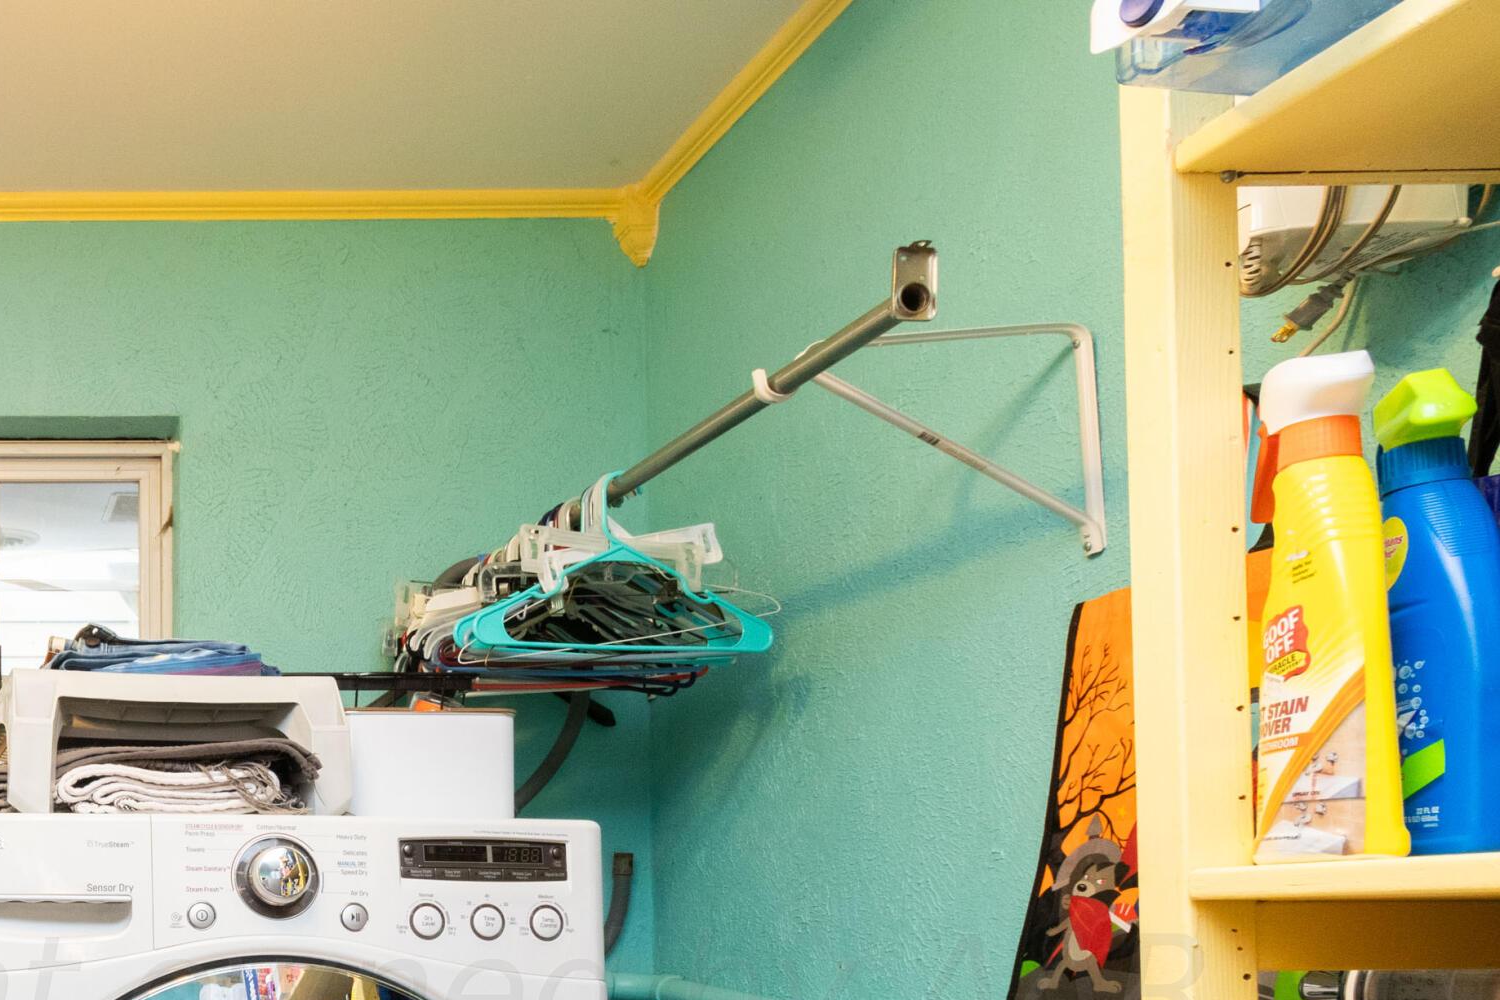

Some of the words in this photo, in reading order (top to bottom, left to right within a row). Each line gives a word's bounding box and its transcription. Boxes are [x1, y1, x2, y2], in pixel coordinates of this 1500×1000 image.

[1265, 631, 1295, 664] OFF
[1267, 695, 1309, 721] STAIN
[86, 883, 116, 892] Sensor
[118, 883, 135, 894] Dry
